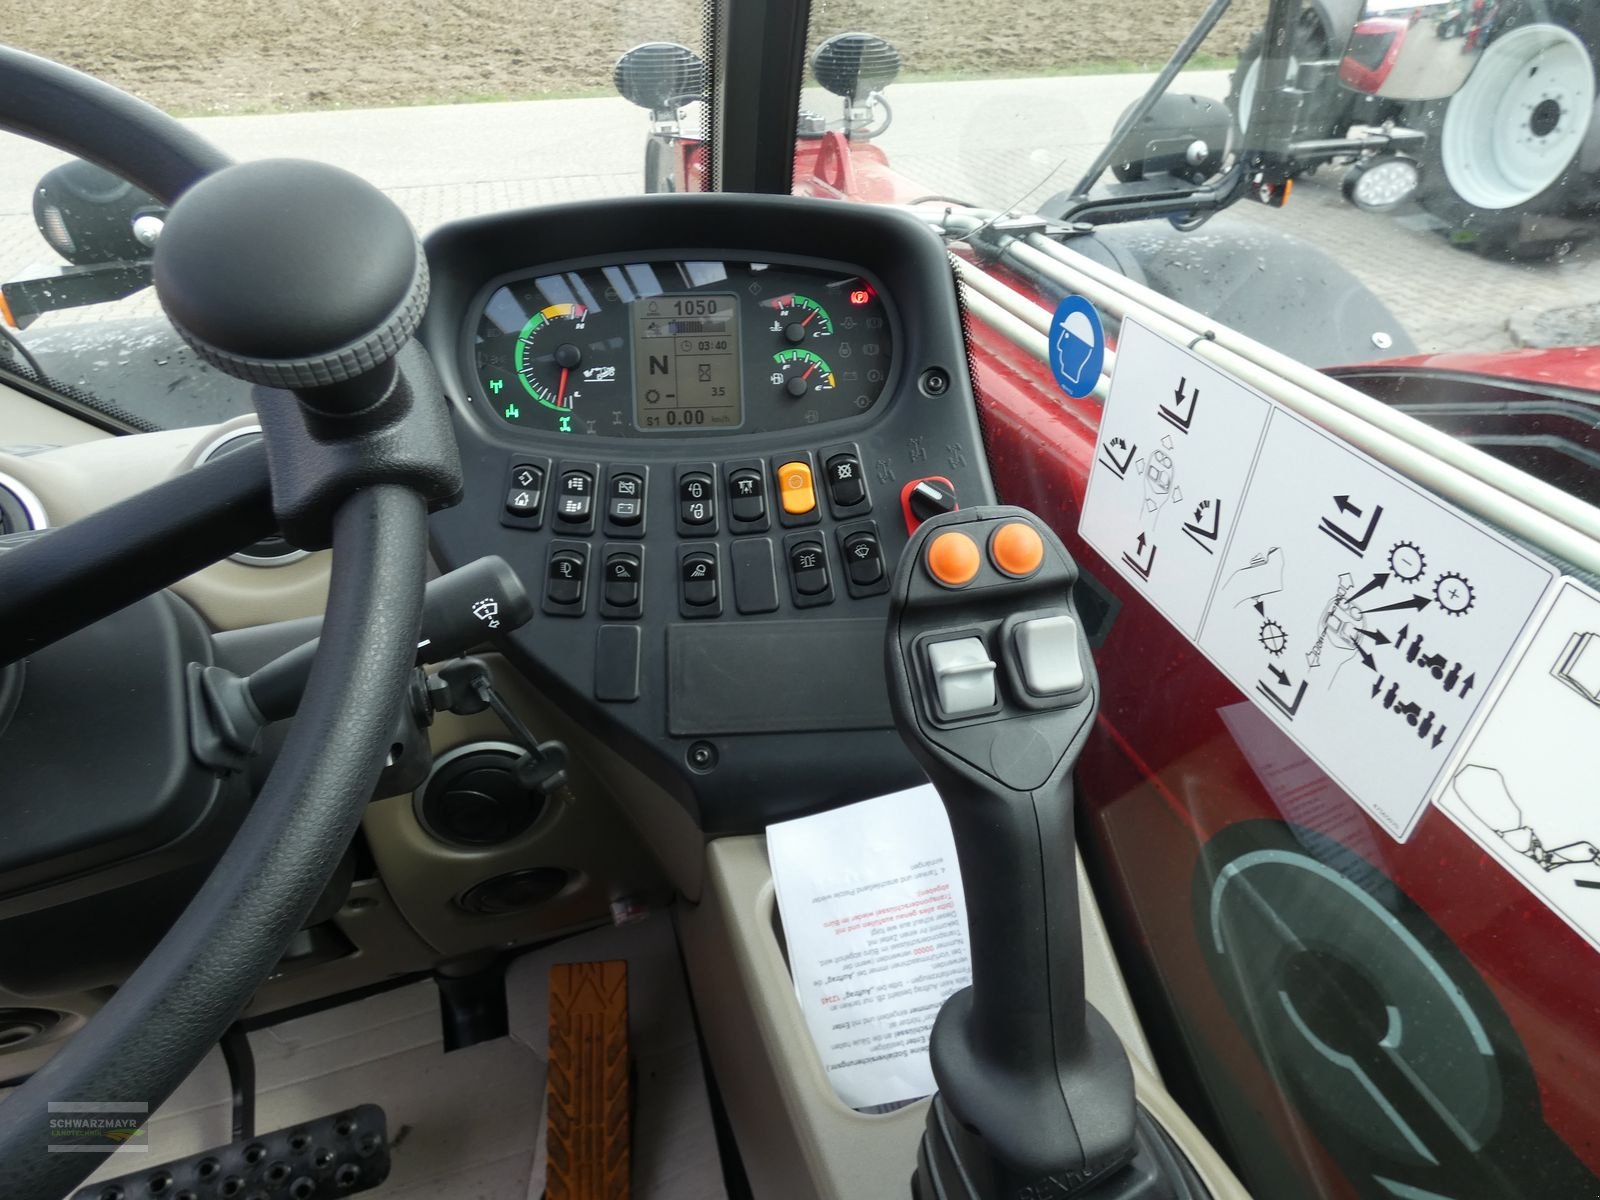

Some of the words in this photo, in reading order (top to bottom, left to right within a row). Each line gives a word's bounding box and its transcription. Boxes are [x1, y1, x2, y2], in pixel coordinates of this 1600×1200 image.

[674, 299, 717, 316] 1050
[698, 340, 728, 351] 03:40
[649, 355, 669, 375] N
[666, 409, 705, 426] 0.00
